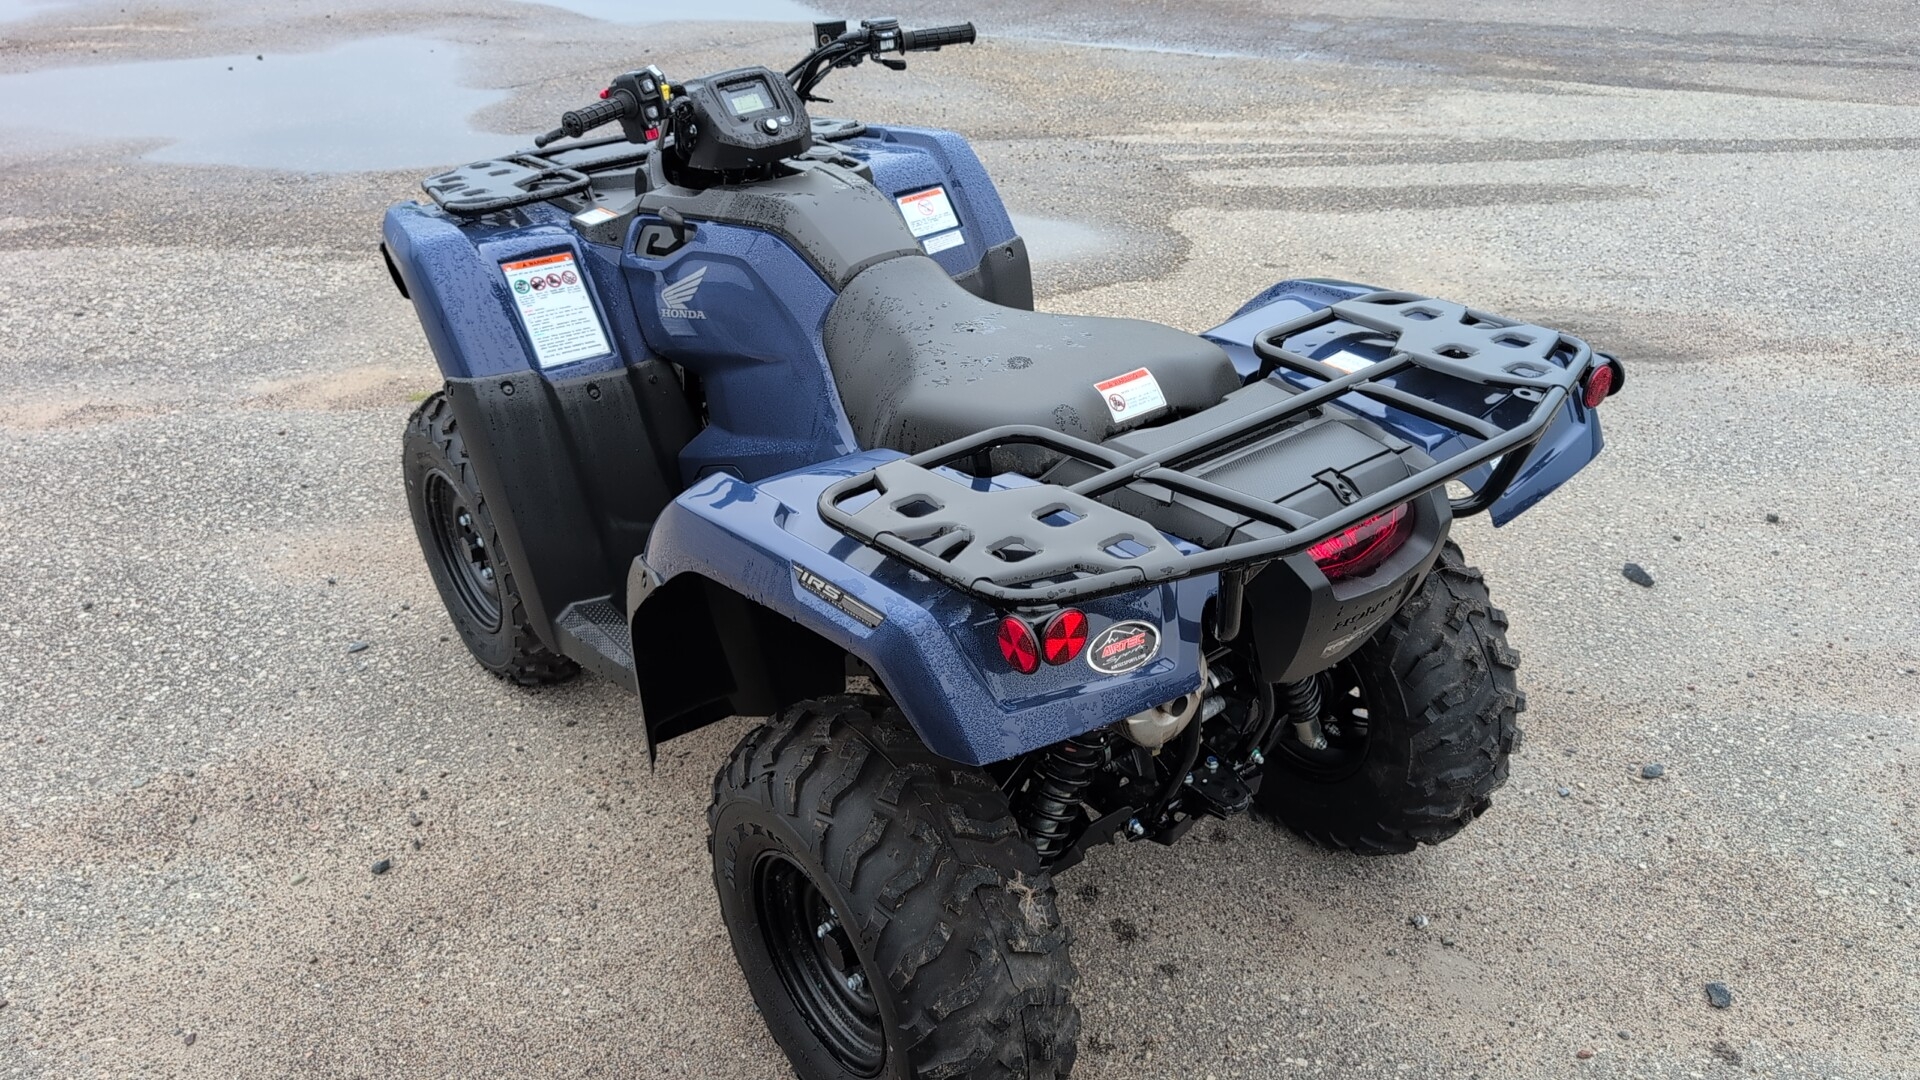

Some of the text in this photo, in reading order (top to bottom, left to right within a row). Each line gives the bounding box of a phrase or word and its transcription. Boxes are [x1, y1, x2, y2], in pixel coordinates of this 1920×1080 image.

[661, 308, 707, 320] HONDA
[801, 571, 841, 601] IRS
[1101, 632, 1146, 658] AIRTEC
